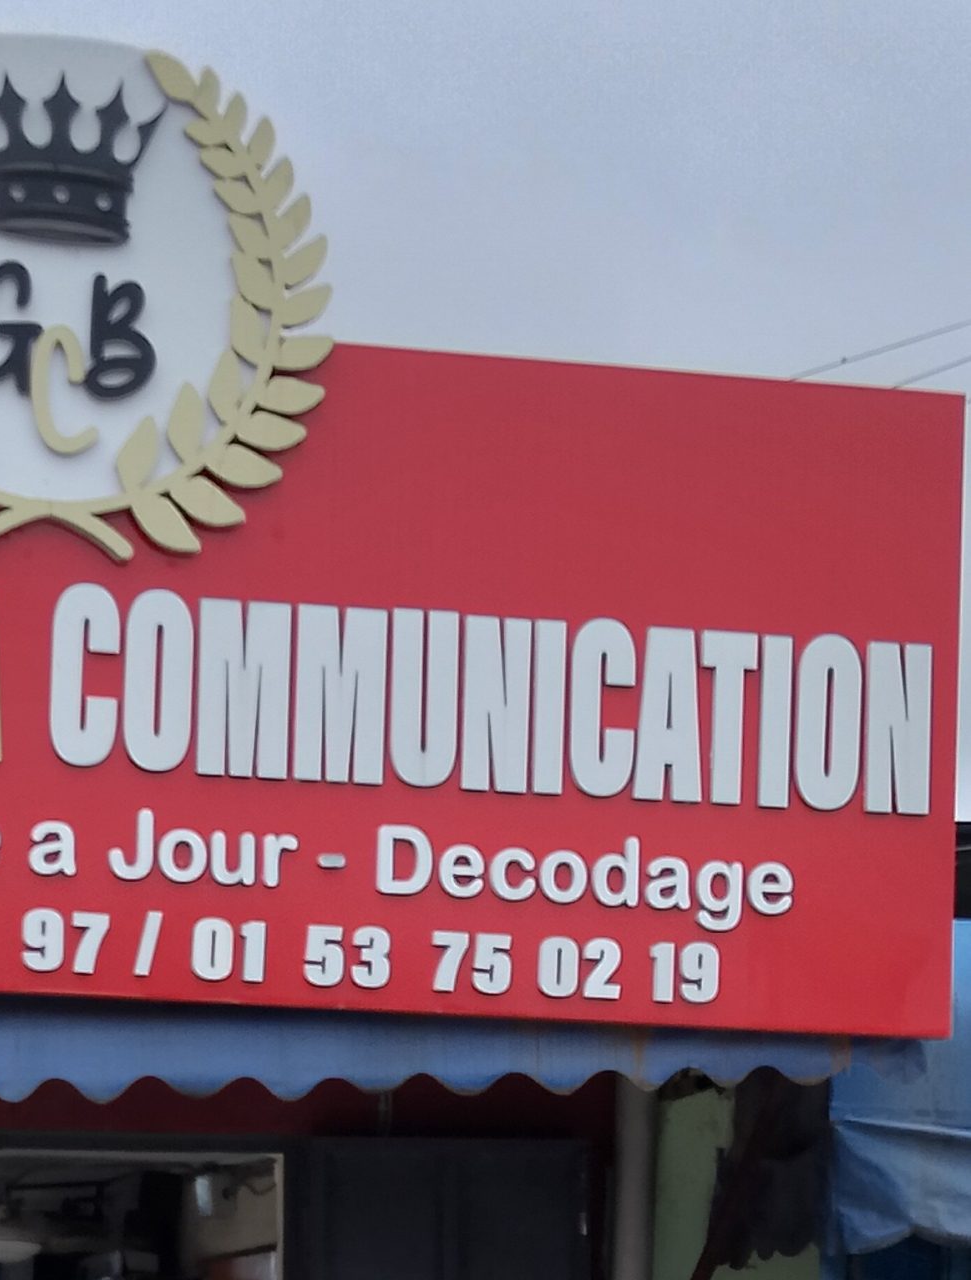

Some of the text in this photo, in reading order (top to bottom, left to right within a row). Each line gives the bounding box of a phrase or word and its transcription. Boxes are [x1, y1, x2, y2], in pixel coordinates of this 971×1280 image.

[48, 582, 934, 816] COMMUNICATION
[27, 820, 78, 877] a
[107, 807, 299, 889] Jour
[316, 852, 347, 869] -
[375, 824, 795, 932] Decodage
[21, 907, 111, 974] 97
[133, 910, 164, 976] /
[190, 916, 267, 983] 01
[303, 924, 391, 988] 53
[431, 929, 513, 994] 75
[537, 935, 622, 1000] 02
[649, 941, 720, 1003] 19
